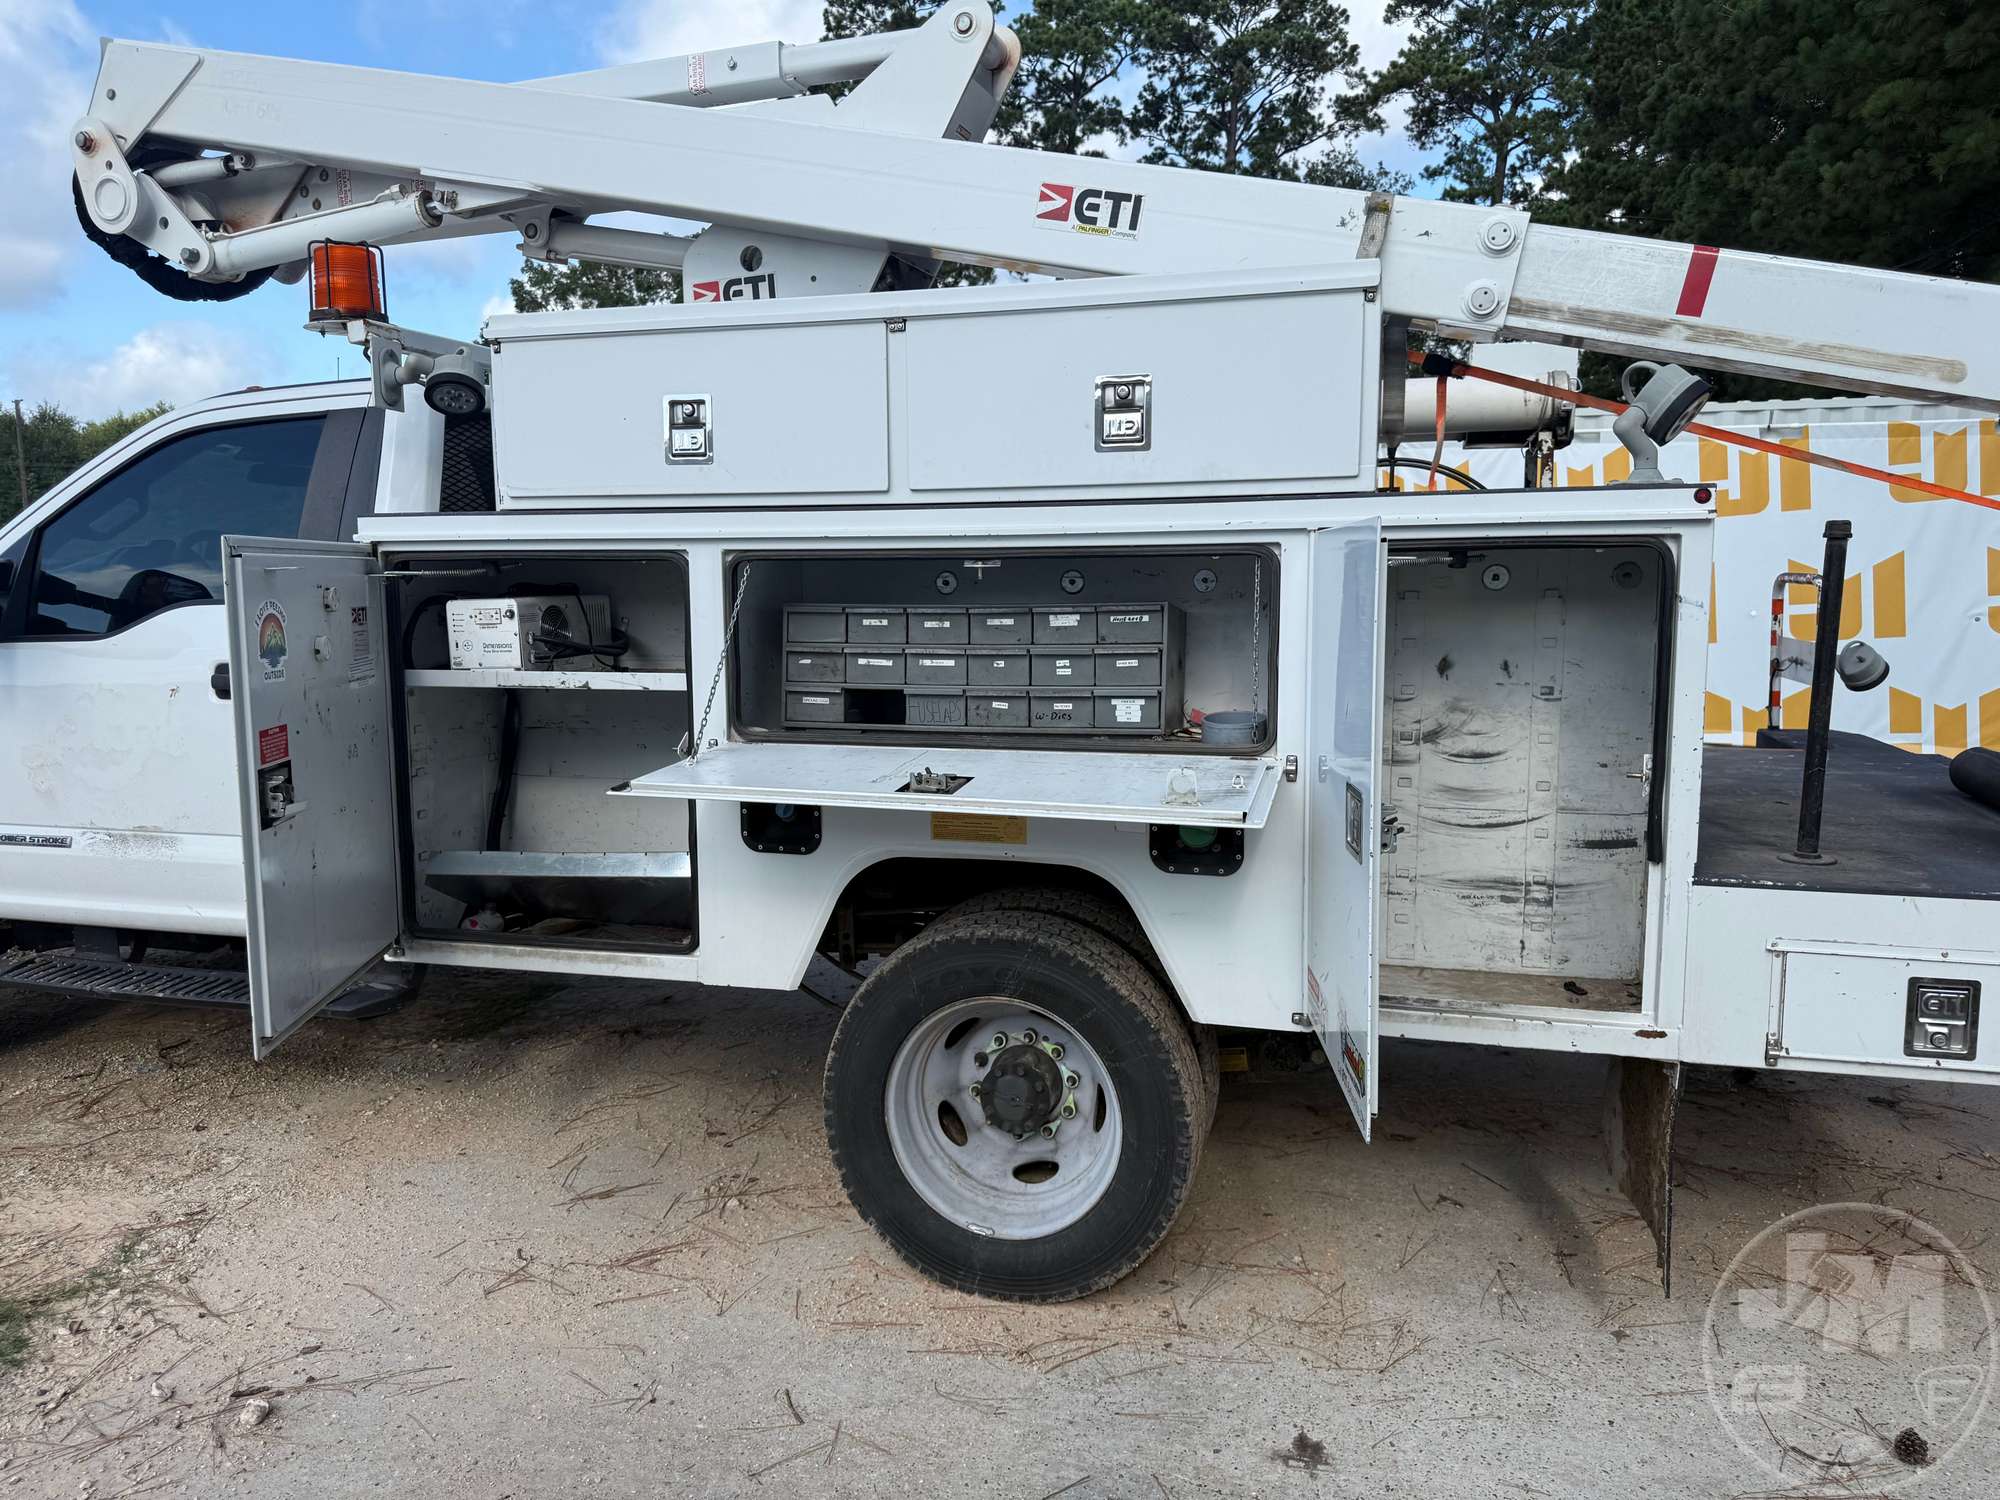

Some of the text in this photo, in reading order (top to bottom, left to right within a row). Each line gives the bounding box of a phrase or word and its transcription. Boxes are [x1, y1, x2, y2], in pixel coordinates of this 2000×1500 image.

[1074, 189, 1143, 231] ETI
[1077, 225, 1110, 236] PALFINGER
[1112, 230, 1137, 240] Company
[722, 273, 776, 302] ETI
[264, 669, 285, 681] OUTSIDE
[0, 834, 68, 845] OWER STROKE
